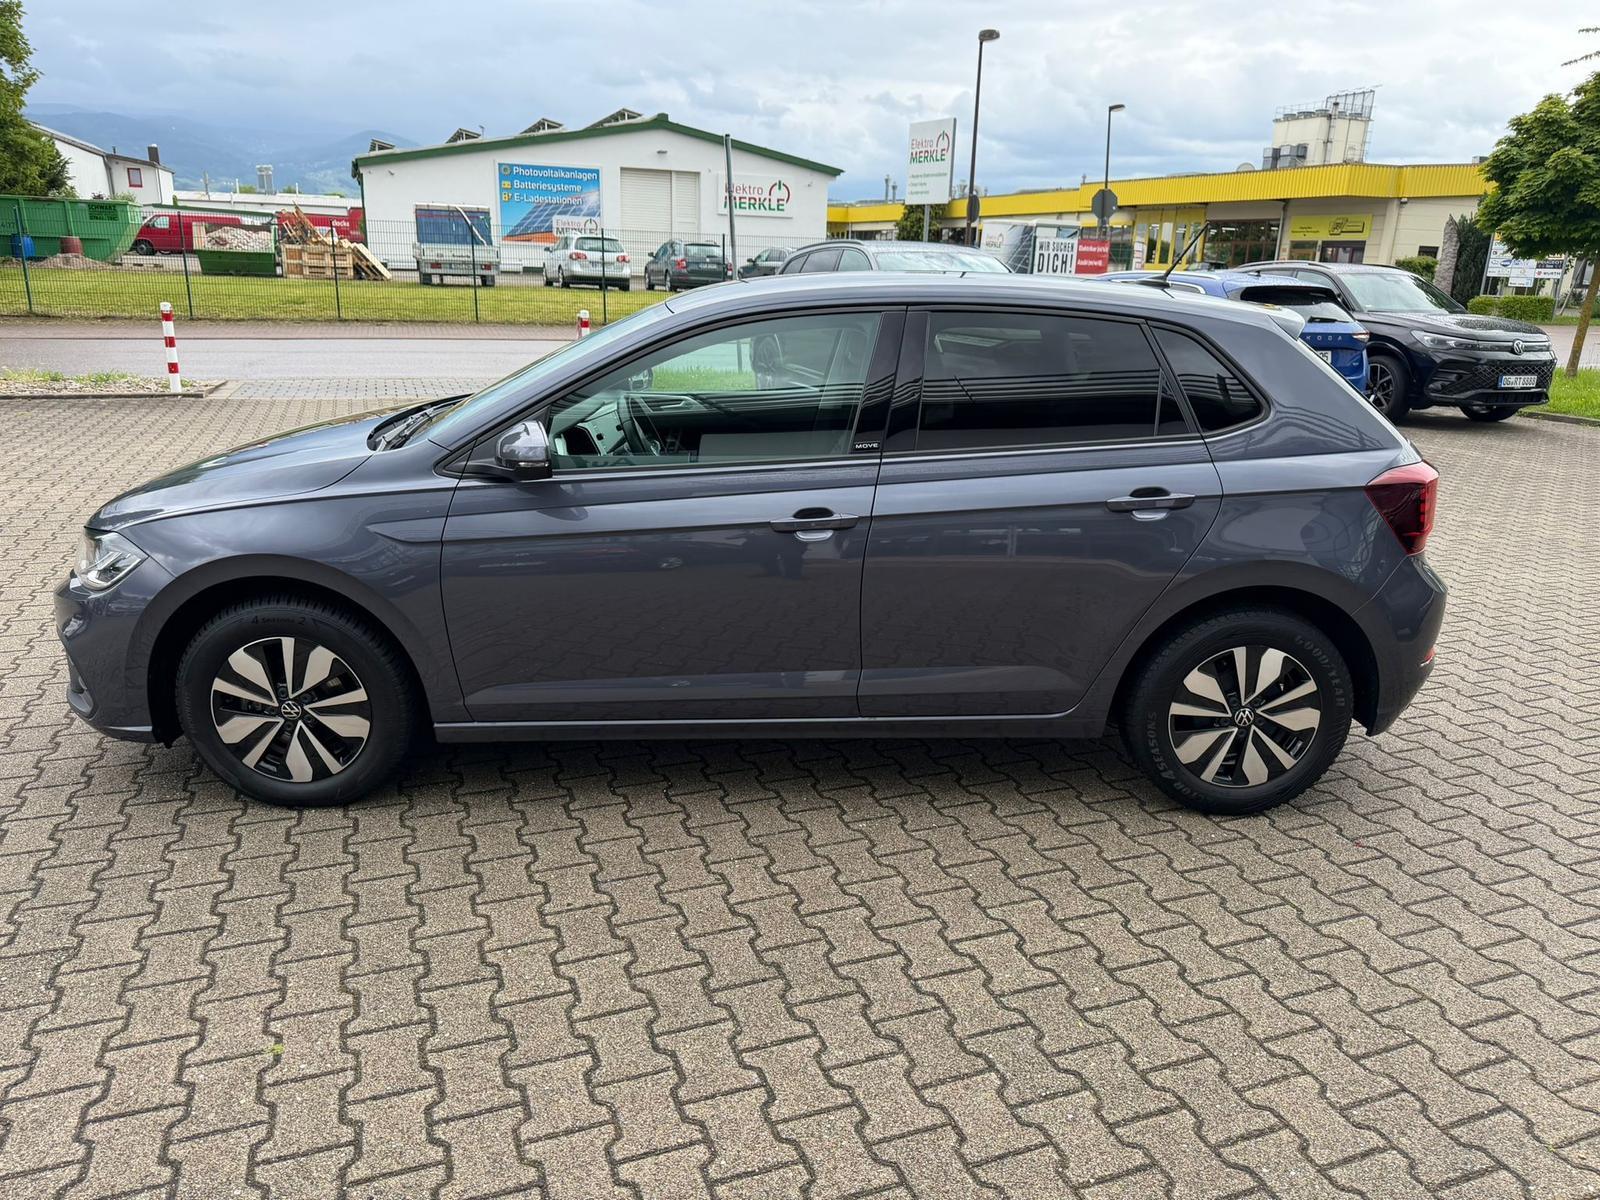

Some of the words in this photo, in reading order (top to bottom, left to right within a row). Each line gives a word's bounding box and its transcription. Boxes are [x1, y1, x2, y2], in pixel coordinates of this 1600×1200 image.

[911, 138, 934, 150] Elektro
[910, 148, 946, 165] MERKLE
[513, 166, 597, 181] Photovoltaikanlagen
[513, 180, 582, 193] Batteriesysteme
[514, 193, 582, 205] E-Ladestationen
[724, 195, 785, 212] MERKLE
[1038, 241, 1050, 251] WIR
[1052, 242, 1074, 253] SUCHEN
[1037, 253, 1074, 274] DICH!
